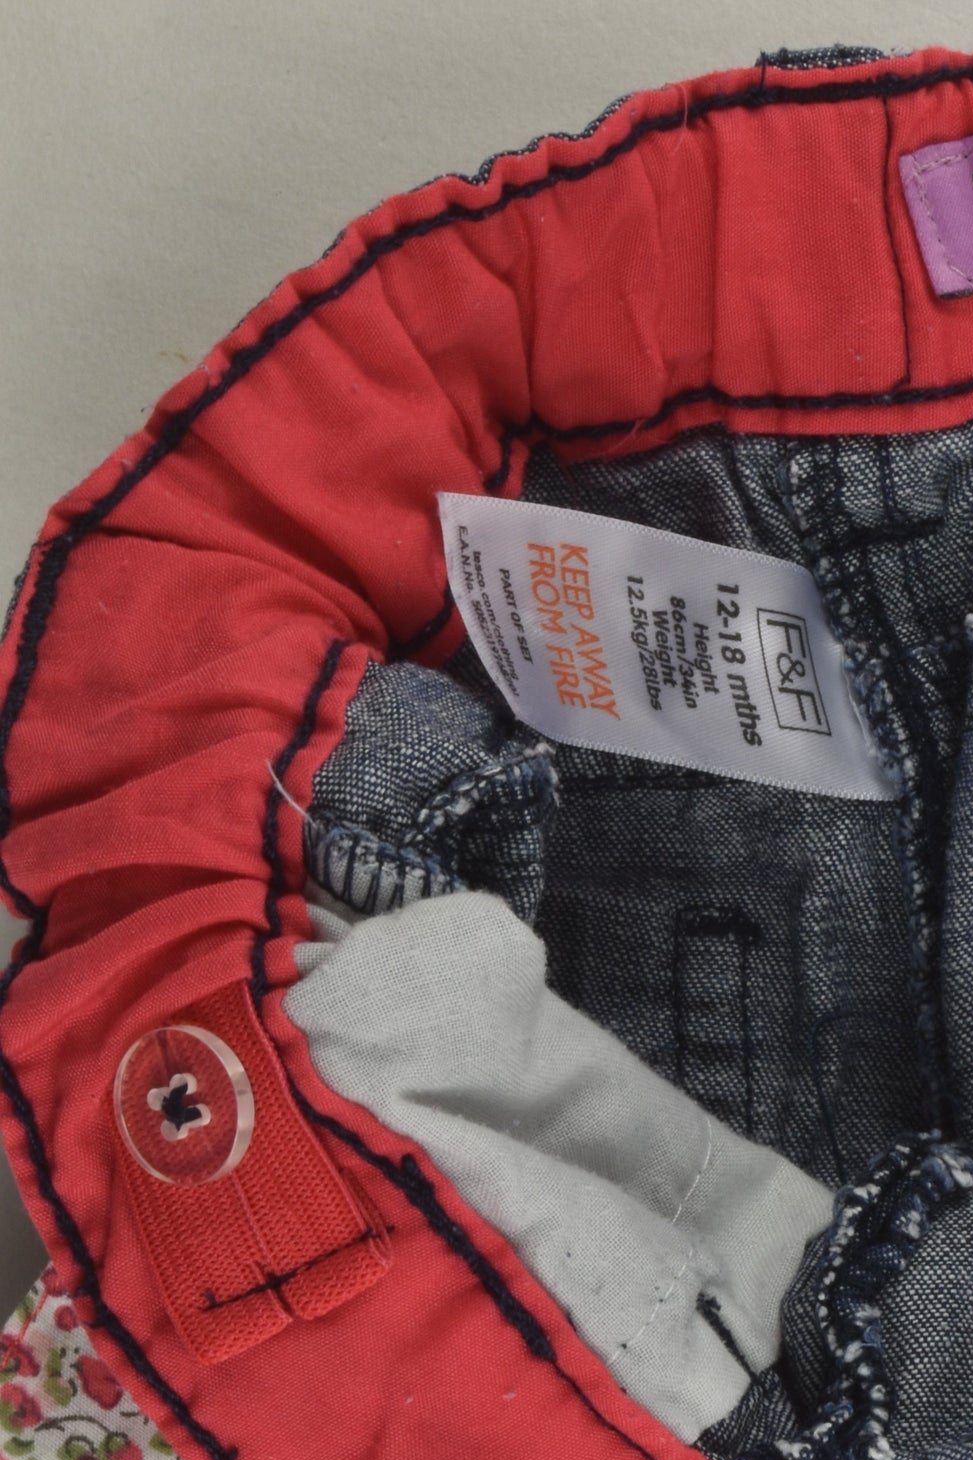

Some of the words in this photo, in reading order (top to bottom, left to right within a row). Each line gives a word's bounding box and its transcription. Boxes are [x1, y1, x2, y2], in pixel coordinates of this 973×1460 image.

[499, 568, 518, 610] PART
[528, 542, 567, 634] FROM
[559, 543, 594, 620] KEEP
[510, 612, 525, 633] OF
[517, 635, 534, 664] SET
[627, 575, 662, 711] 12.5kg/28lbs
[652, 610, 677, 688] Weight
[670, 596, 700, 709] 86cm/34in
[693, 622, 720, 694] Height
[716, 584, 746, 665] 12-18
[545, 644, 587, 708] FIRE
[570, 624, 621, 720] AWAY
[727, 673, 762, 746] mths
[766, 618, 822, 726] F&F
